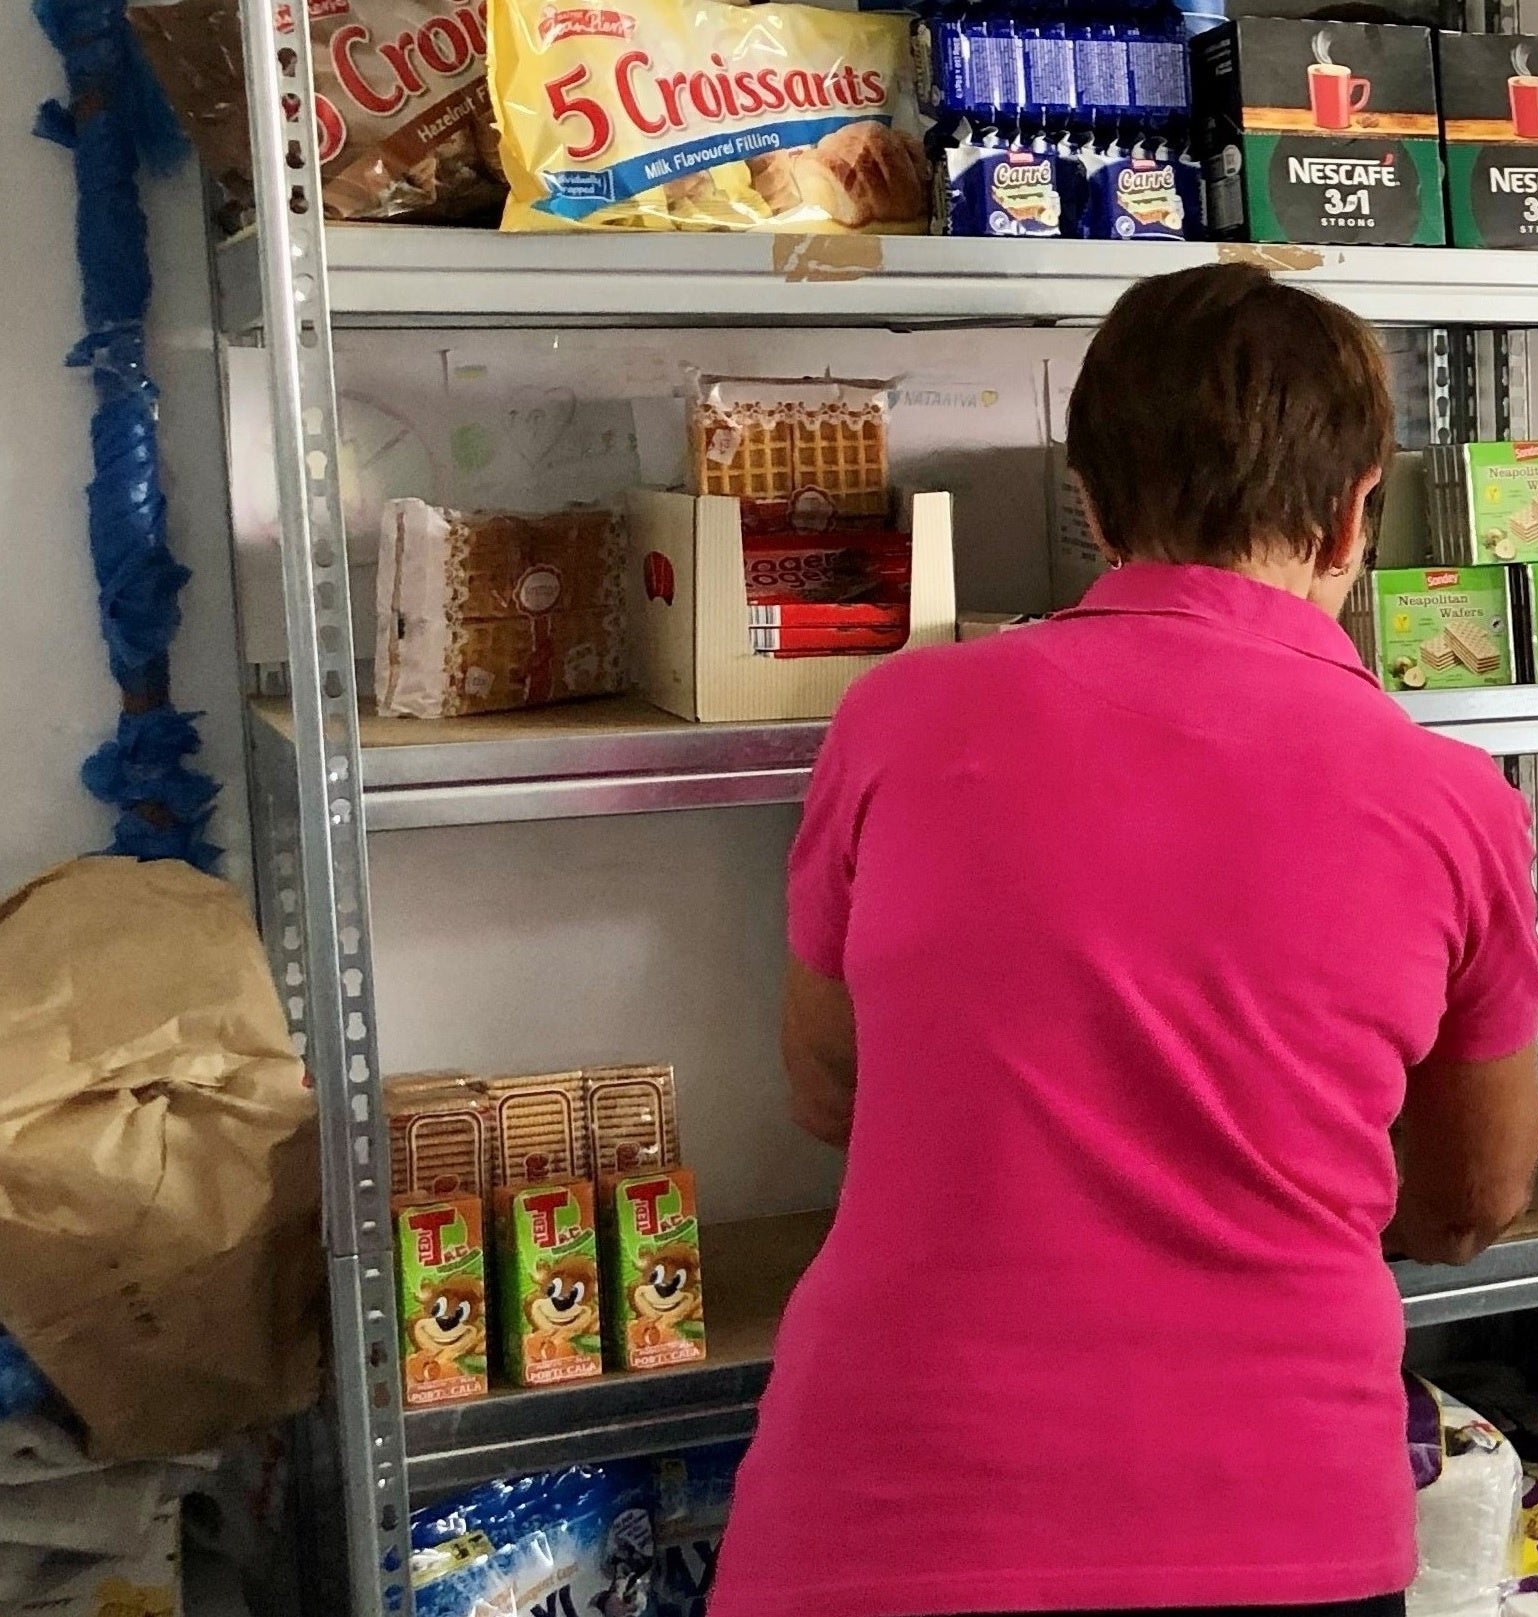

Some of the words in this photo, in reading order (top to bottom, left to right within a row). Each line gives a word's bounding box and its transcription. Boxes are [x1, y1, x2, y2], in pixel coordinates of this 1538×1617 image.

[416, 98, 476, 143] Hazelnut
[544, 63, 610, 158] 5
[614, 50, 886, 134] Croissants
[644, 160, 672, 180] Milk
[736, 133, 780, 154] Filling
[1288, 153, 1398, 187] NESCAFÉ
[994, 160, 1052, 188] Carré
[1118, 165, 1175, 193] Carré
[1320, 218, 1375, 229] STRONG
[1398, 594, 1468, 607] Neapolitan
[1440, 607, 1484, 618] Wafers
[532, 1211, 547, 1247] TEDI
[636, 1198, 651, 1232] TEDI
[418, 1230, 433, 1263] TEDI
